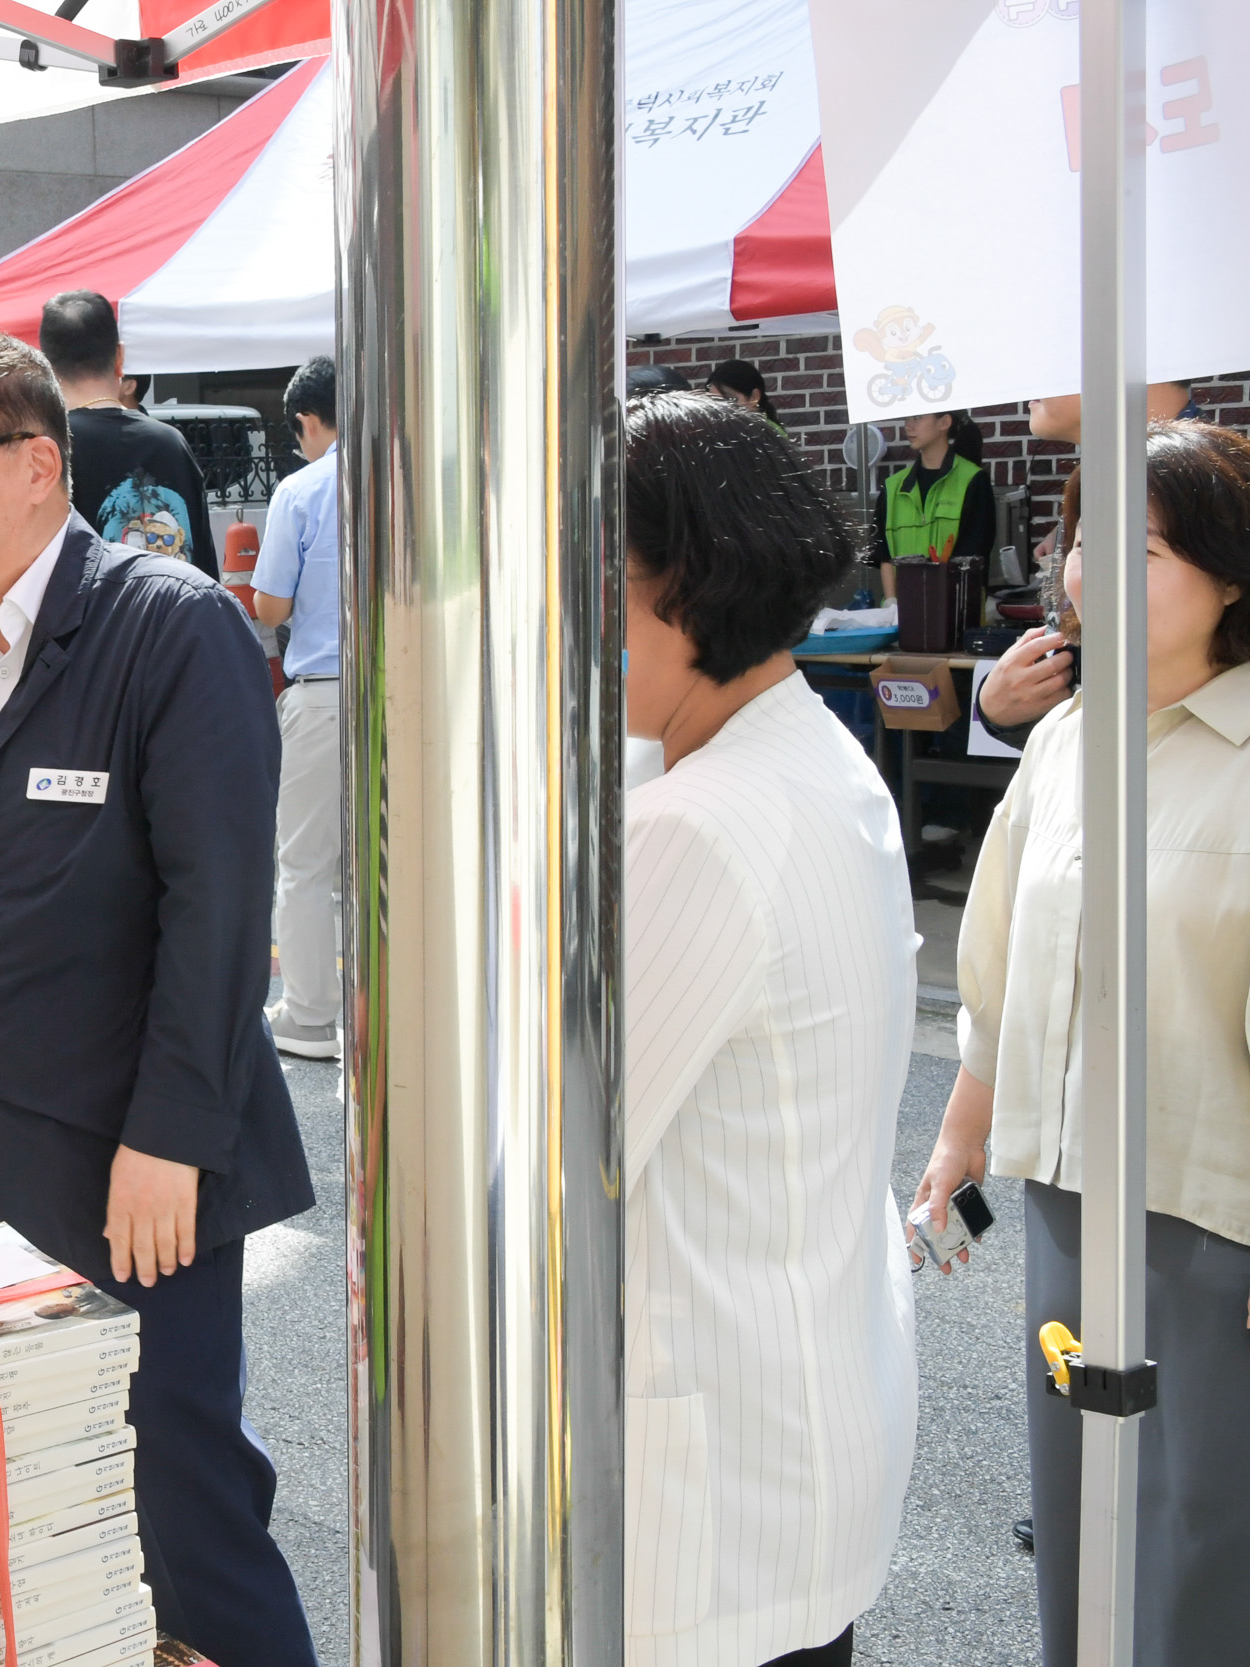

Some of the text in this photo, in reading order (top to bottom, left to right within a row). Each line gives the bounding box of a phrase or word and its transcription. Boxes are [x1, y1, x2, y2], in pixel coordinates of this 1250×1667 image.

[893, 693, 924, 704] 3,000원
[60, 788, 95, 798] 광진구청장
[14, 1462, 41, 1475] 나이트
[28, 1522, 55, 1536] 하이디
